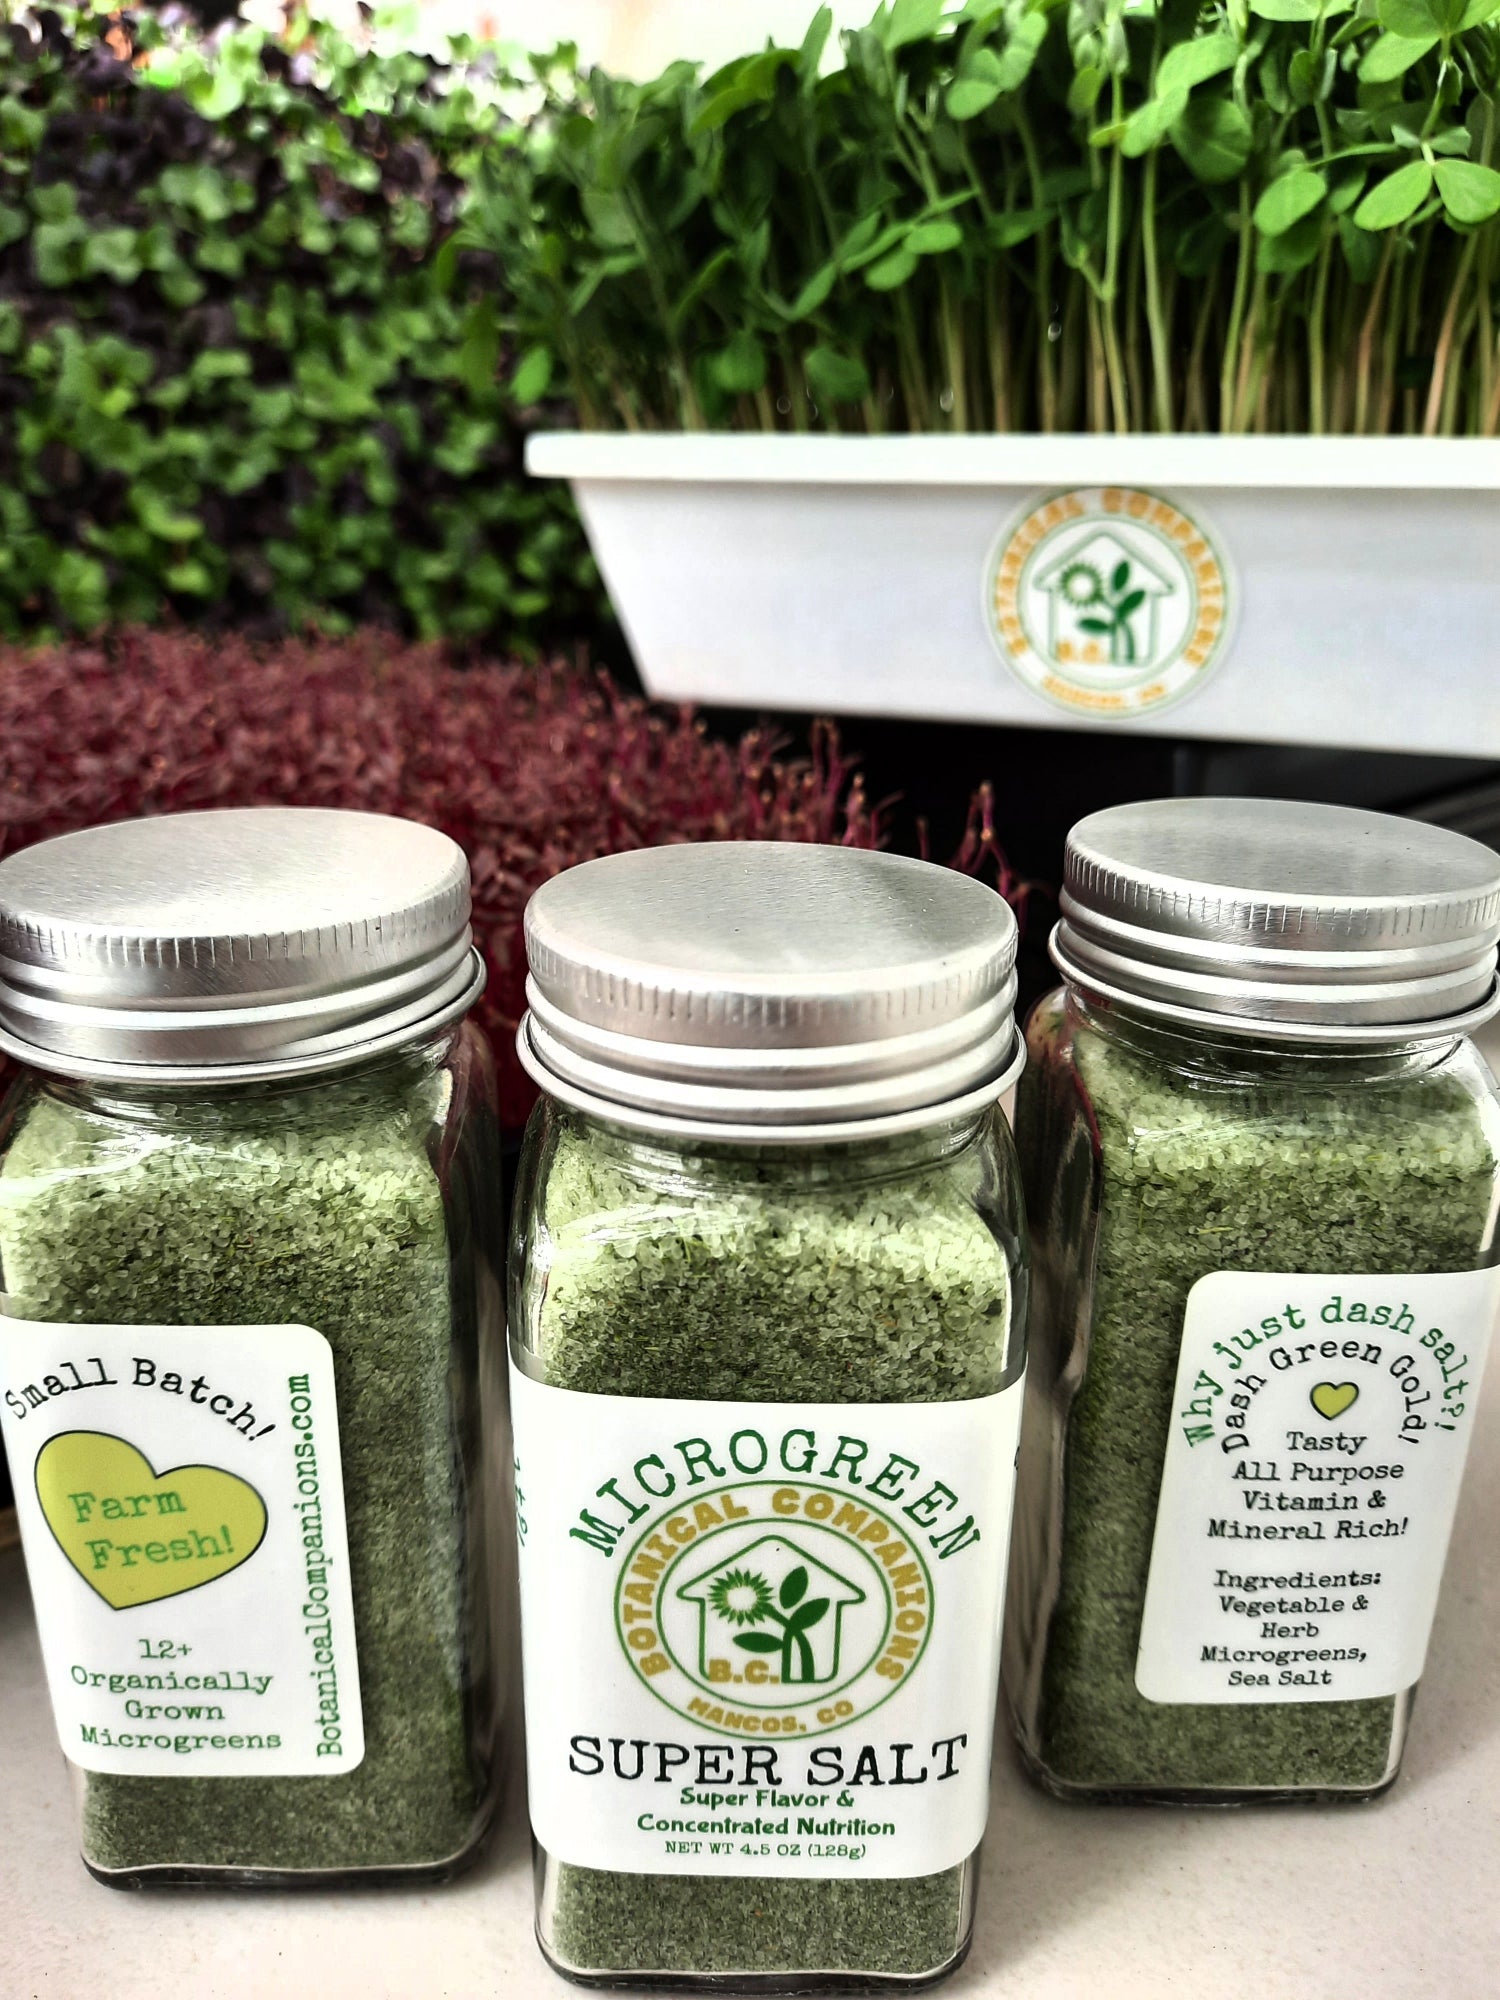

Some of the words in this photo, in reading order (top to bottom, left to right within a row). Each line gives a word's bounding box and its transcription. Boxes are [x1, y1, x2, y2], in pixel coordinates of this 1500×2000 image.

[1180, 1368, 1225, 1449] Why
[1211, 1304, 1306, 1370] just
[1320, 1296, 1416, 1334] dash
[1418, 1327, 1469, 1433] salt?!
[5, 1358, 118, 1419] Small
[132, 1357, 276, 1441] Batch!
[1220, 1373, 1267, 1455] Dash
[1268, 1340, 1382, 1371] Green
[1389, 1354, 1431, 1445] Gold!
[1285, 1430, 1368, 1456] Tasty
[1230, 1460, 1281, 1481] All
[1289, 1461, 1405, 1487] Purpose
[67, 1488, 187, 1523] Farm
[569, 1429, 981, 1560] MICROGREEN
[1242, 1490, 1360, 1511] Vitamin
[1367, 1490, 1387, 1509] &
[1206, 1519, 1326, 1541] Mineral
[1333, 1517, 1410, 1539] Rich!
[85, 1525, 235, 1570] Fresh!
[288, 1373, 342, 1757] BotanicalCompanions.com
[623, 1494, 749, 1677] BOTANICAL
[771, 1488, 927, 1681] COMPANIONS
[1212, 1570, 1383, 1590] Ingredients:
[1219, 1596, 1345, 1617] Vegetable
[1351, 1596, 1369, 1612] &
[1259, 1621, 1320, 1639] Herb
[139, 1639, 193, 1661] 12+
[1199, 1646, 1368, 1664] Microgreens,
[71, 1665, 274, 1693] Organically
[1227, 1670, 1270, 1686] Sea
[1278, 1670, 1333, 1687] Salt
[125, 1700, 225, 1721] Grown
[816, 1700, 853, 1724] CO
[80, 1724, 282, 1754] Microgreens
[569, 1736, 782, 1786] SUPER
[807, 1734, 968, 1786] SALT
[680, 1787, 748, 1810] Super
[756, 1789, 829, 1807] Flavor
[836, 1789, 855, 1807] &
[637, 1813, 789, 1835] Concentrated
[797, 1817, 896, 1836] Nutrition
[665, 1841, 702, 1854] NET
[709, 1842, 734, 1855] WT
[739, 1843, 770, 1856] 4.5
[777, 1844, 801, 1856] OZ
[808, 1843, 867, 1861] (128g)
